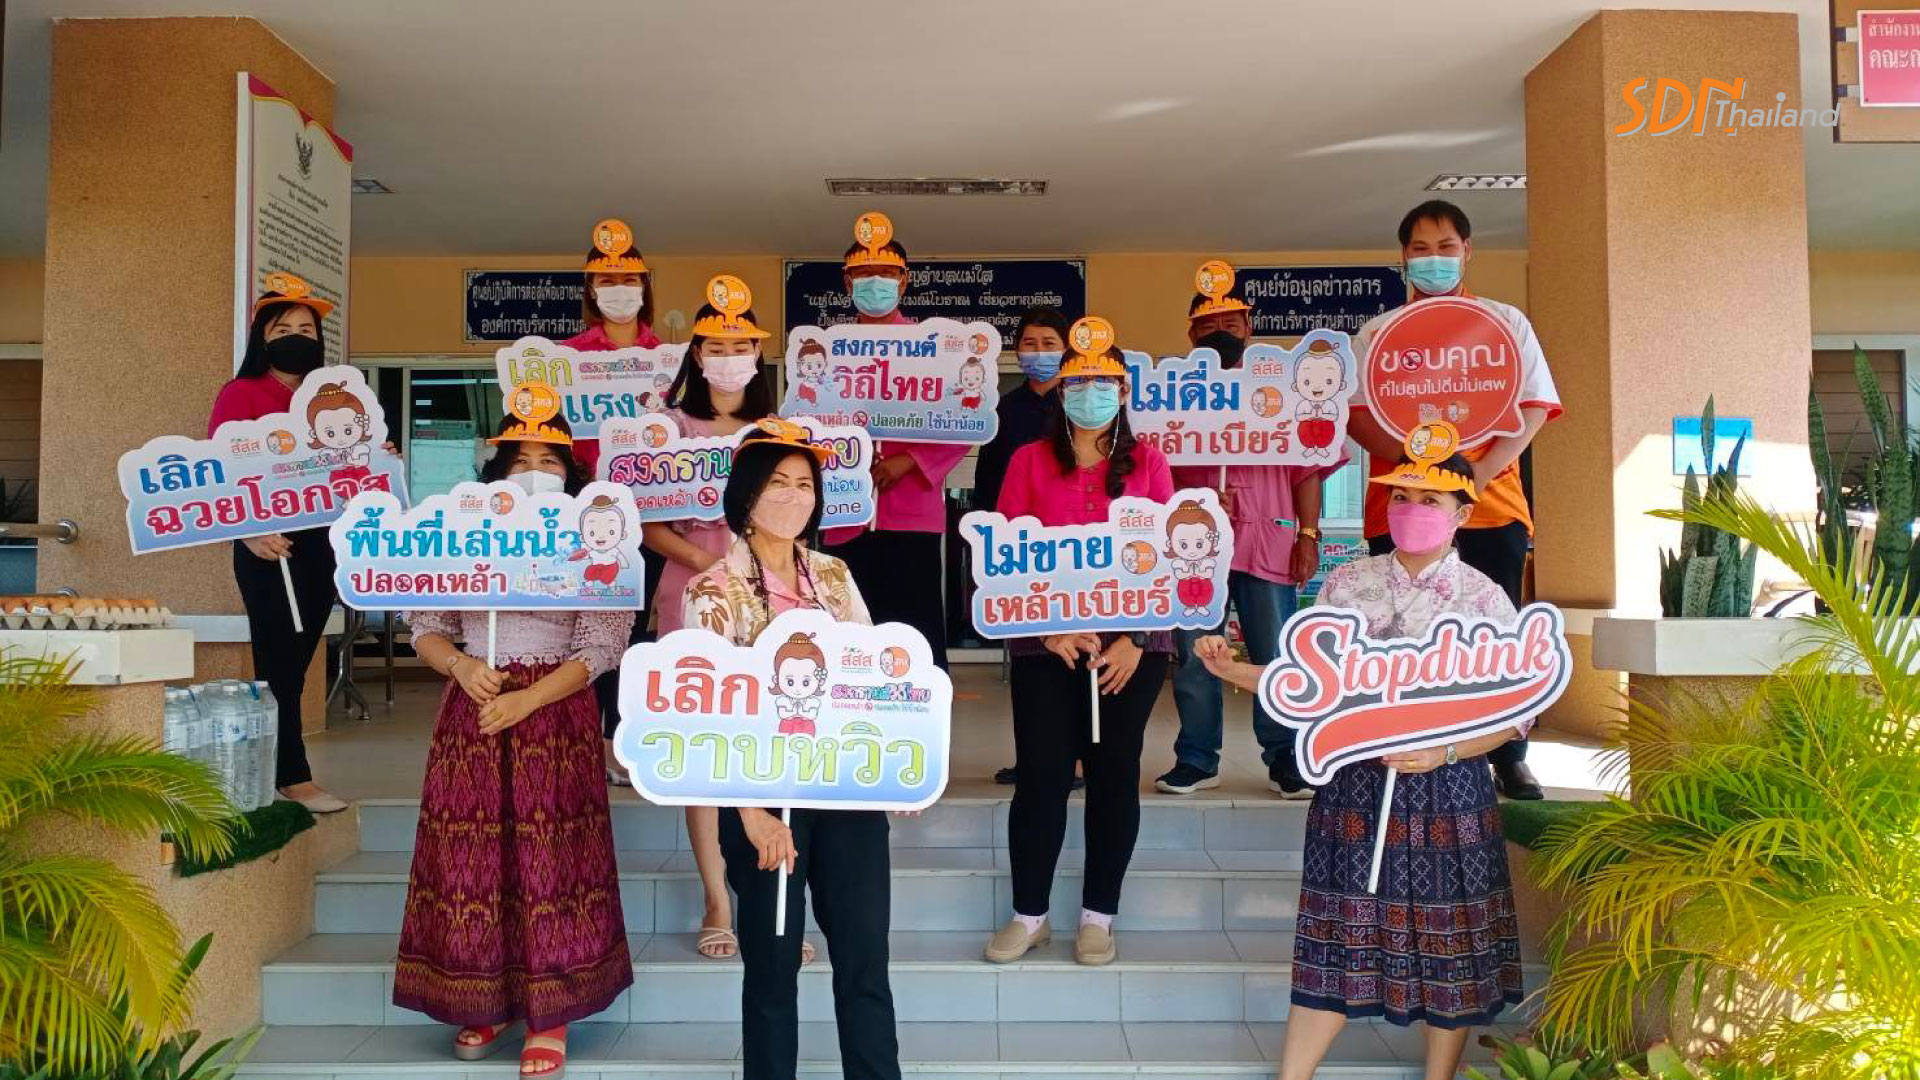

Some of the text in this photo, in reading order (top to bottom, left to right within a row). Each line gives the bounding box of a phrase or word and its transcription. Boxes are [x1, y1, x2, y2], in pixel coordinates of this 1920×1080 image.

[907, 264, 994, 287] ญตำบลแม่ใส
[1245, 273, 1382, 305] ศูนย์ข้อมูลข่าวสาร
[831, 333, 939, 358] สงกรานต์
[509, 346, 573, 387] เลิก
[832, 358, 944, 402] วิถีไทย
[1127, 359, 1240, 412] ไม่ดื่ม
[564, 392, 637, 423] แรง
[871, 410, 924, 429] ปลอดภัย
[927, 408, 986, 432] ใช้น้ำน้อย
[1136, 419, 1292, 455] หล้า เบียร์
[139, 454, 225, 494] เลิก
[610, 446, 733, 487] สงกราน
[824, 475, 860, 493] น้อย
[635, 487, 694, 509] อดเหล้า
[822, 501, 862, 515] one
[345, 507, 583, 558] พื้นที่เล่นน้ำ
[972, 524, 1113, 577] ไม่ขาย
[1274, 615, 1556, 714] Stopdrink
[646, 655, 760, 716] เลิก
[641, 721, 926, 785] วาบหวิว
